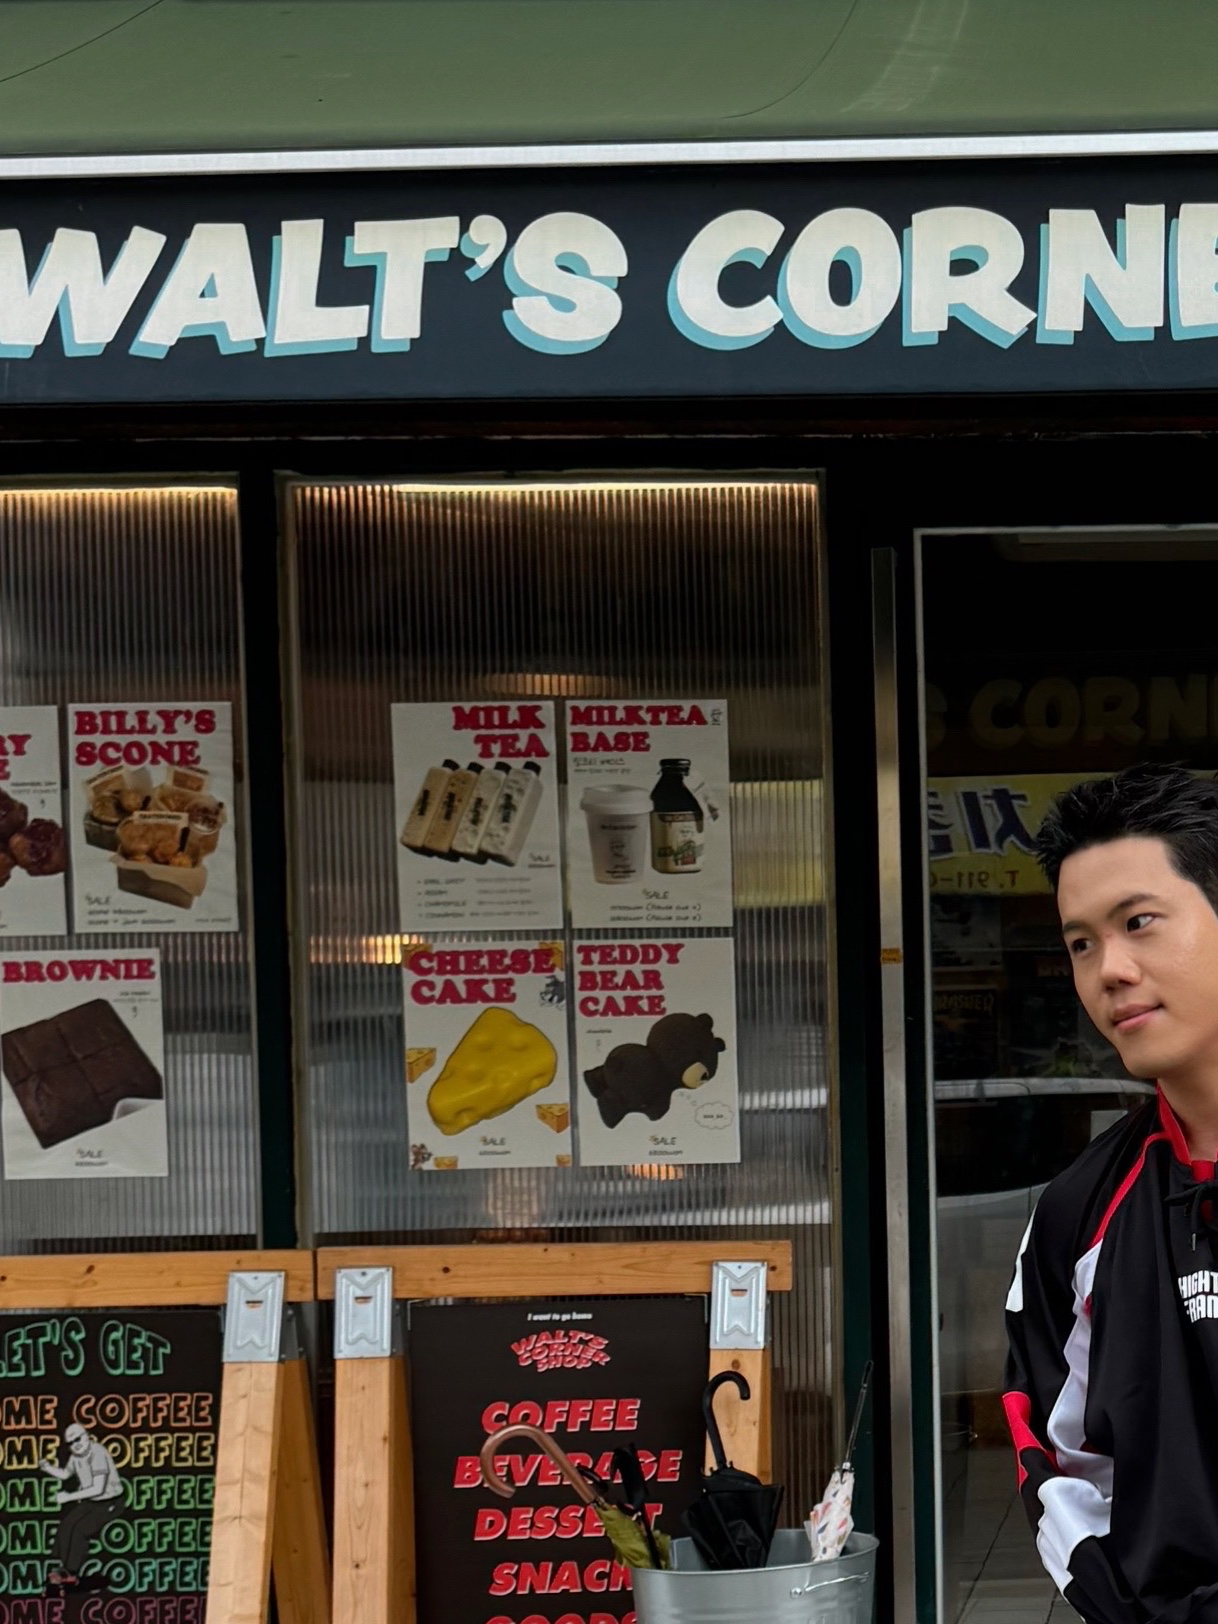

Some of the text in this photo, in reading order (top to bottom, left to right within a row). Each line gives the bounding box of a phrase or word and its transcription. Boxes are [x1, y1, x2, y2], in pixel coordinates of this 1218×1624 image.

[452, 705, 546, 730] MILK
[570, 705, 709, 726] MILKTEA
[75, 740, 202, 767] SCONE
[474, 734, 549, 758] TEA
[570, 731, 651, 752] BASE
[409, 949, 558, 977] CHEESE
[577, 943, 685, 966] TEDDY
[2, 958, 156, 983] BROWNIE
[578, 969, 665, 992] BEAR
[410, 978, 517, 1005] CAKE
[579, 995, 667, 1017] CAKE
[0, 1316, 172, 1377] ET'S GET
[0, 1393, 214, 1430] ME COFFEE
[481, 1398, 641, 1436] COFFEE
[0, 1433, 215, 1470] ME OFFEE
[0, 1477, 62, 1512] ME
[474, 1503, 663, 1541] DESSET
[88, 1518, 214, 1554] OFFEE
